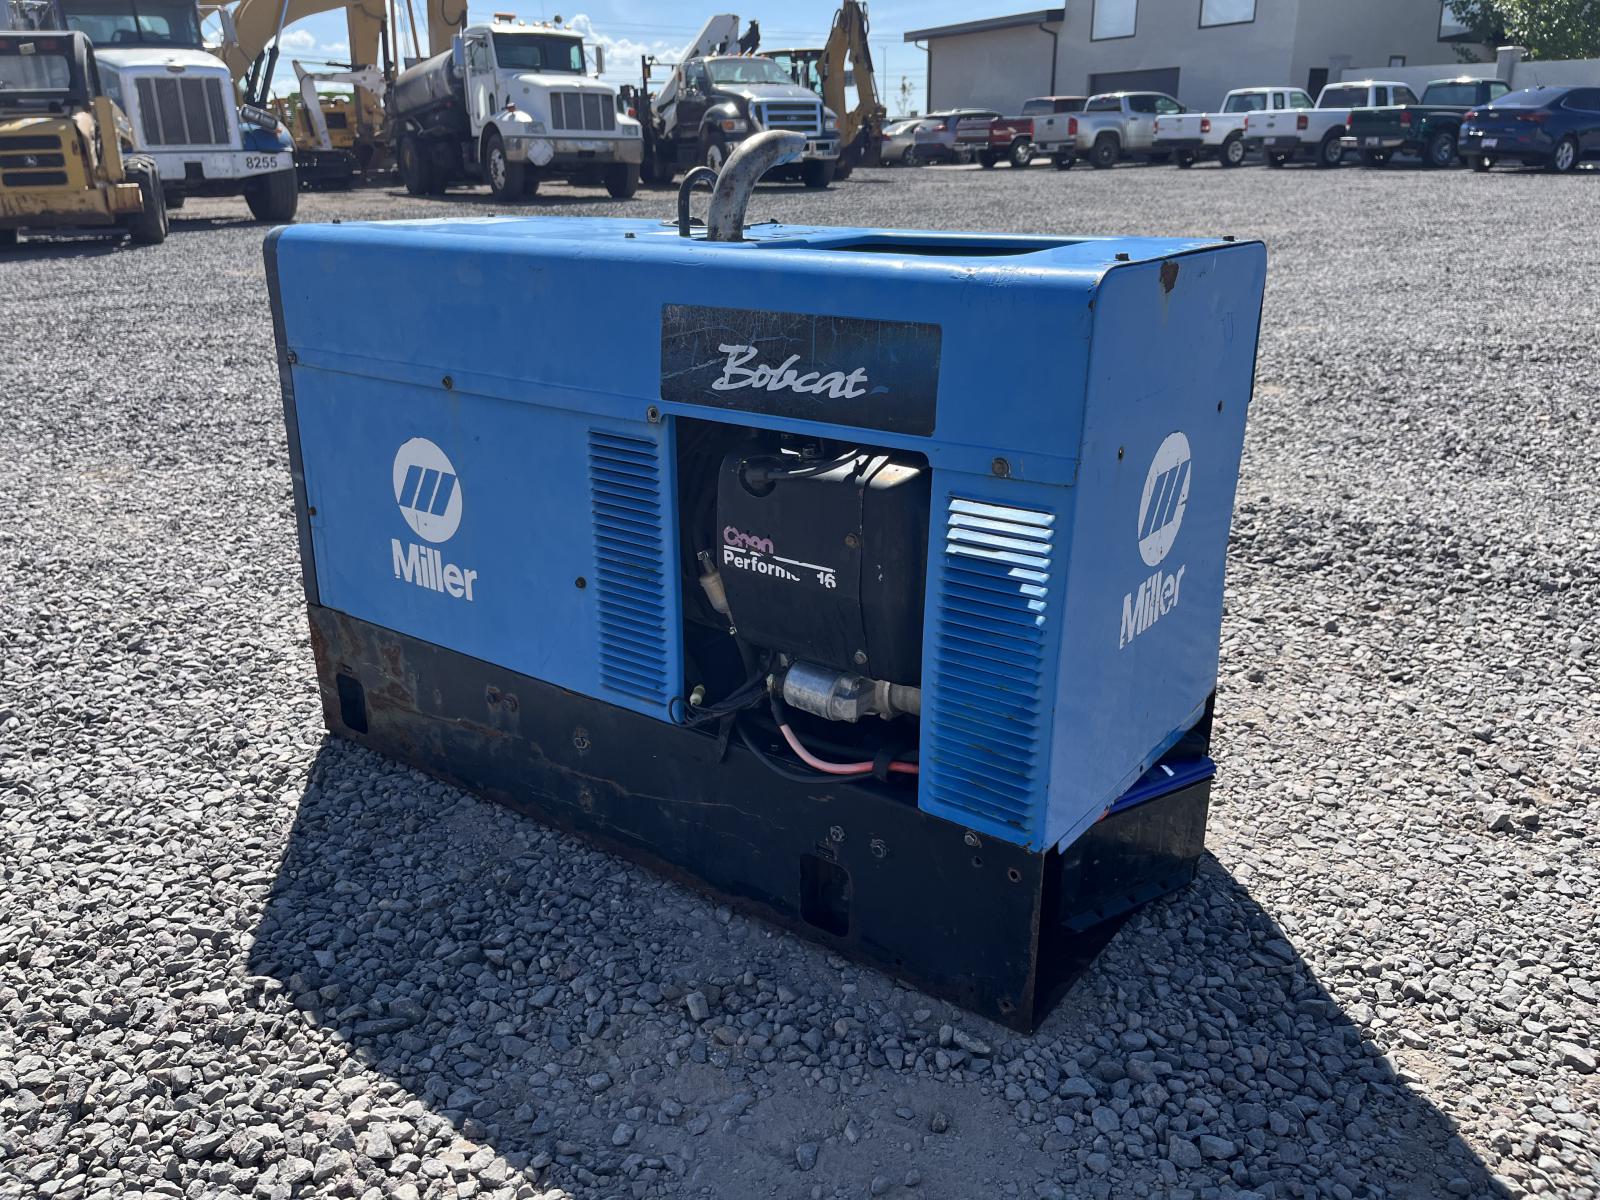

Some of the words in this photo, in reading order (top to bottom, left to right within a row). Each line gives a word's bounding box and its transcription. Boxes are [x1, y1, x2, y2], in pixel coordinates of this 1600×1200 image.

[246, 156, 278, 169] 8255
[712, 343, 868, 399] Bobcat
[391, 538, 478, 602] Miller
[816, 571, 837, 589] 16
[1120, 564, 1186, 650] Miller
